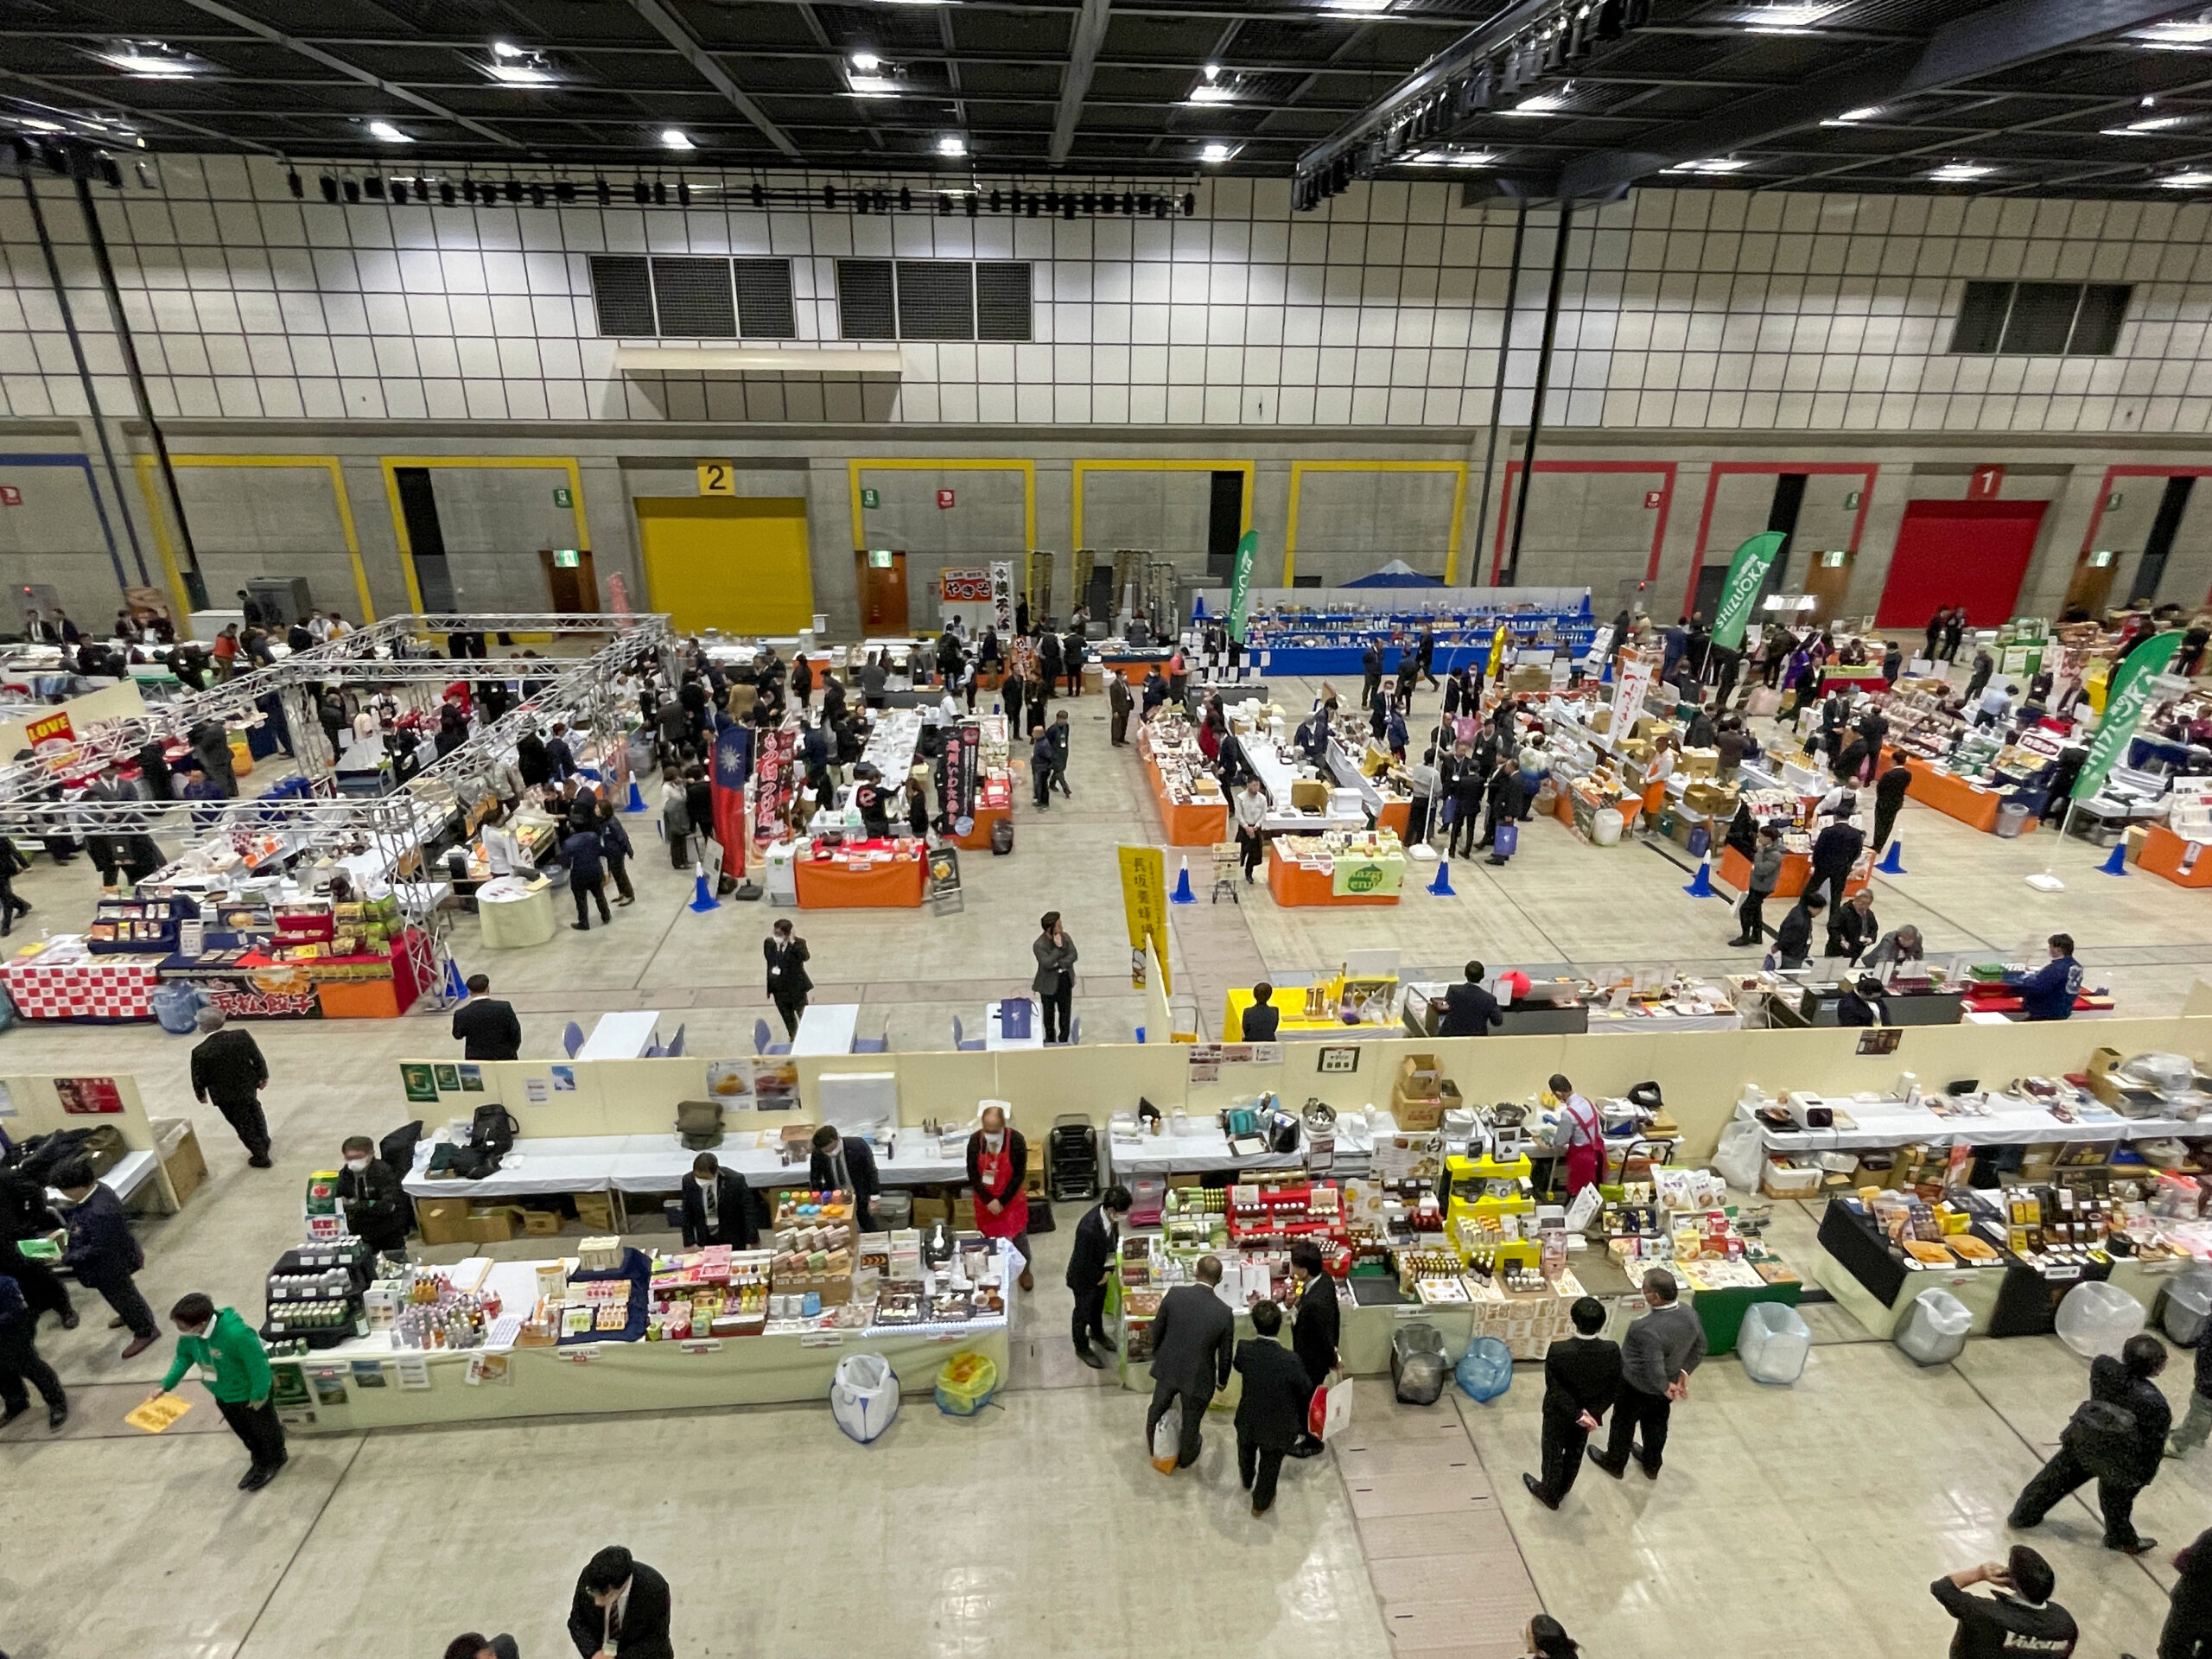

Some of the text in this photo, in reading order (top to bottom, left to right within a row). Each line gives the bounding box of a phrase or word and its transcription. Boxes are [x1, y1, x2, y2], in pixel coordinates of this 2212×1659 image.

[707, 465, 727, 490] 2
[1982, 470, 1994, 493] 1
[946, 582, 991, 599] やきそ
[1715, 560, 1770, 629] SHIZUOKA
[27, 715, 69, 742] LOVE
[210, 993, 316, 1015] 浜松餃子
